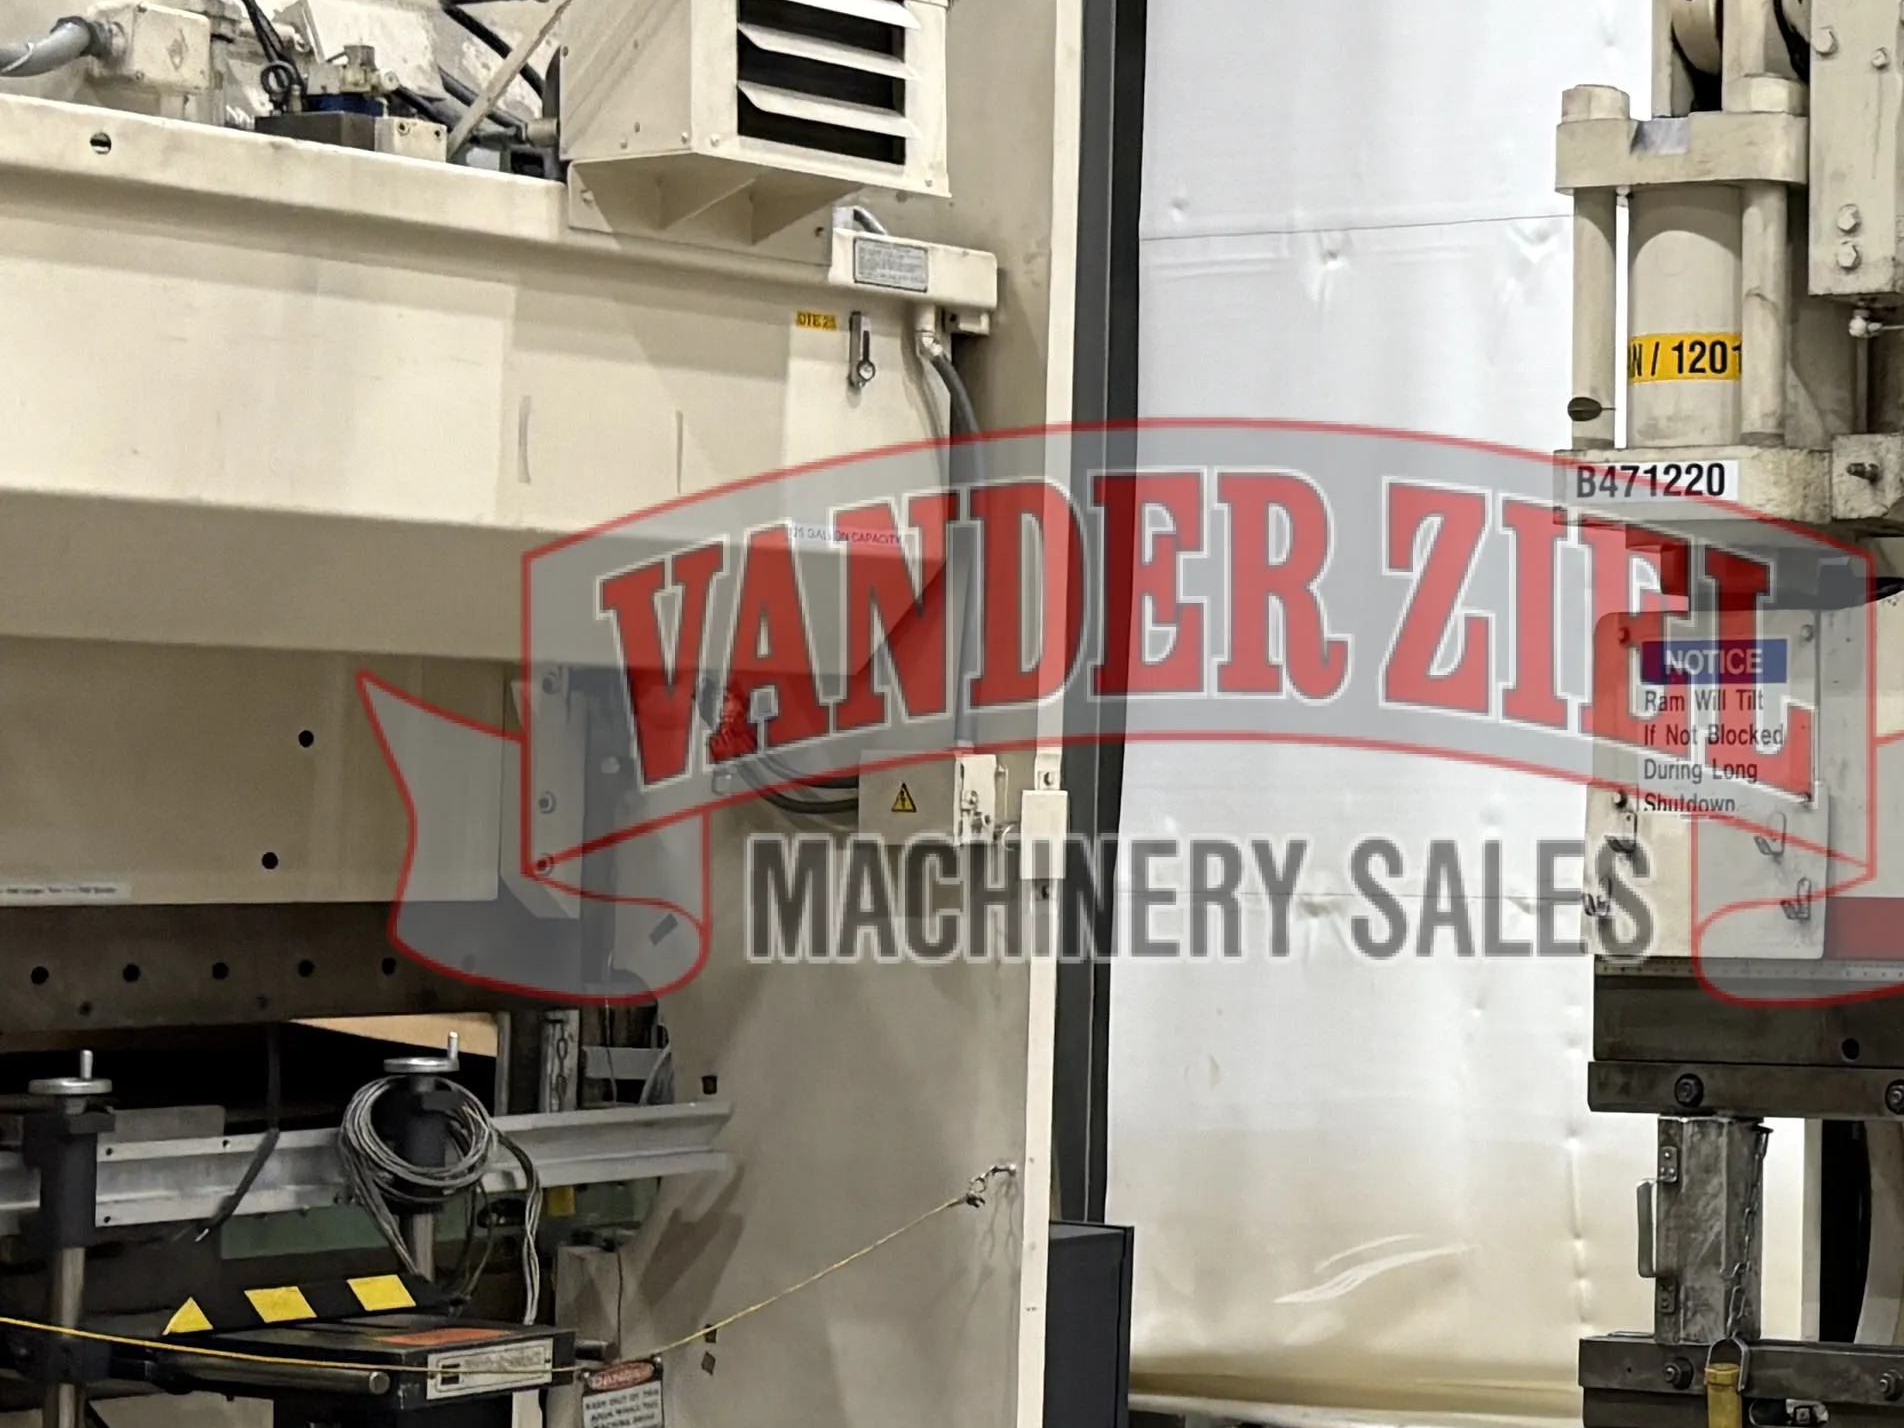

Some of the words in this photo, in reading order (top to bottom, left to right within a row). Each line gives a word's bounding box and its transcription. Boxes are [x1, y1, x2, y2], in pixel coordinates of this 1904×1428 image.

[1576, 463, 1725, 499] B471220
[1666, 649, 1763, 675] NOTICE
[1645, 691, 1685, 711] Ram
[1694, 689, 1726, 711] Will
[1736, 690, 1764, 710] Tilt
[1644, 724, 1656, 746] If
[1666, 724, 1697, 745] Not
[1708, 723, 1784, 746] Blocked
[1644, 759, 1702, 784] During
[1713, 758, 1757, 782] Long
[1644, 792, 1735, 812] Shutdown
